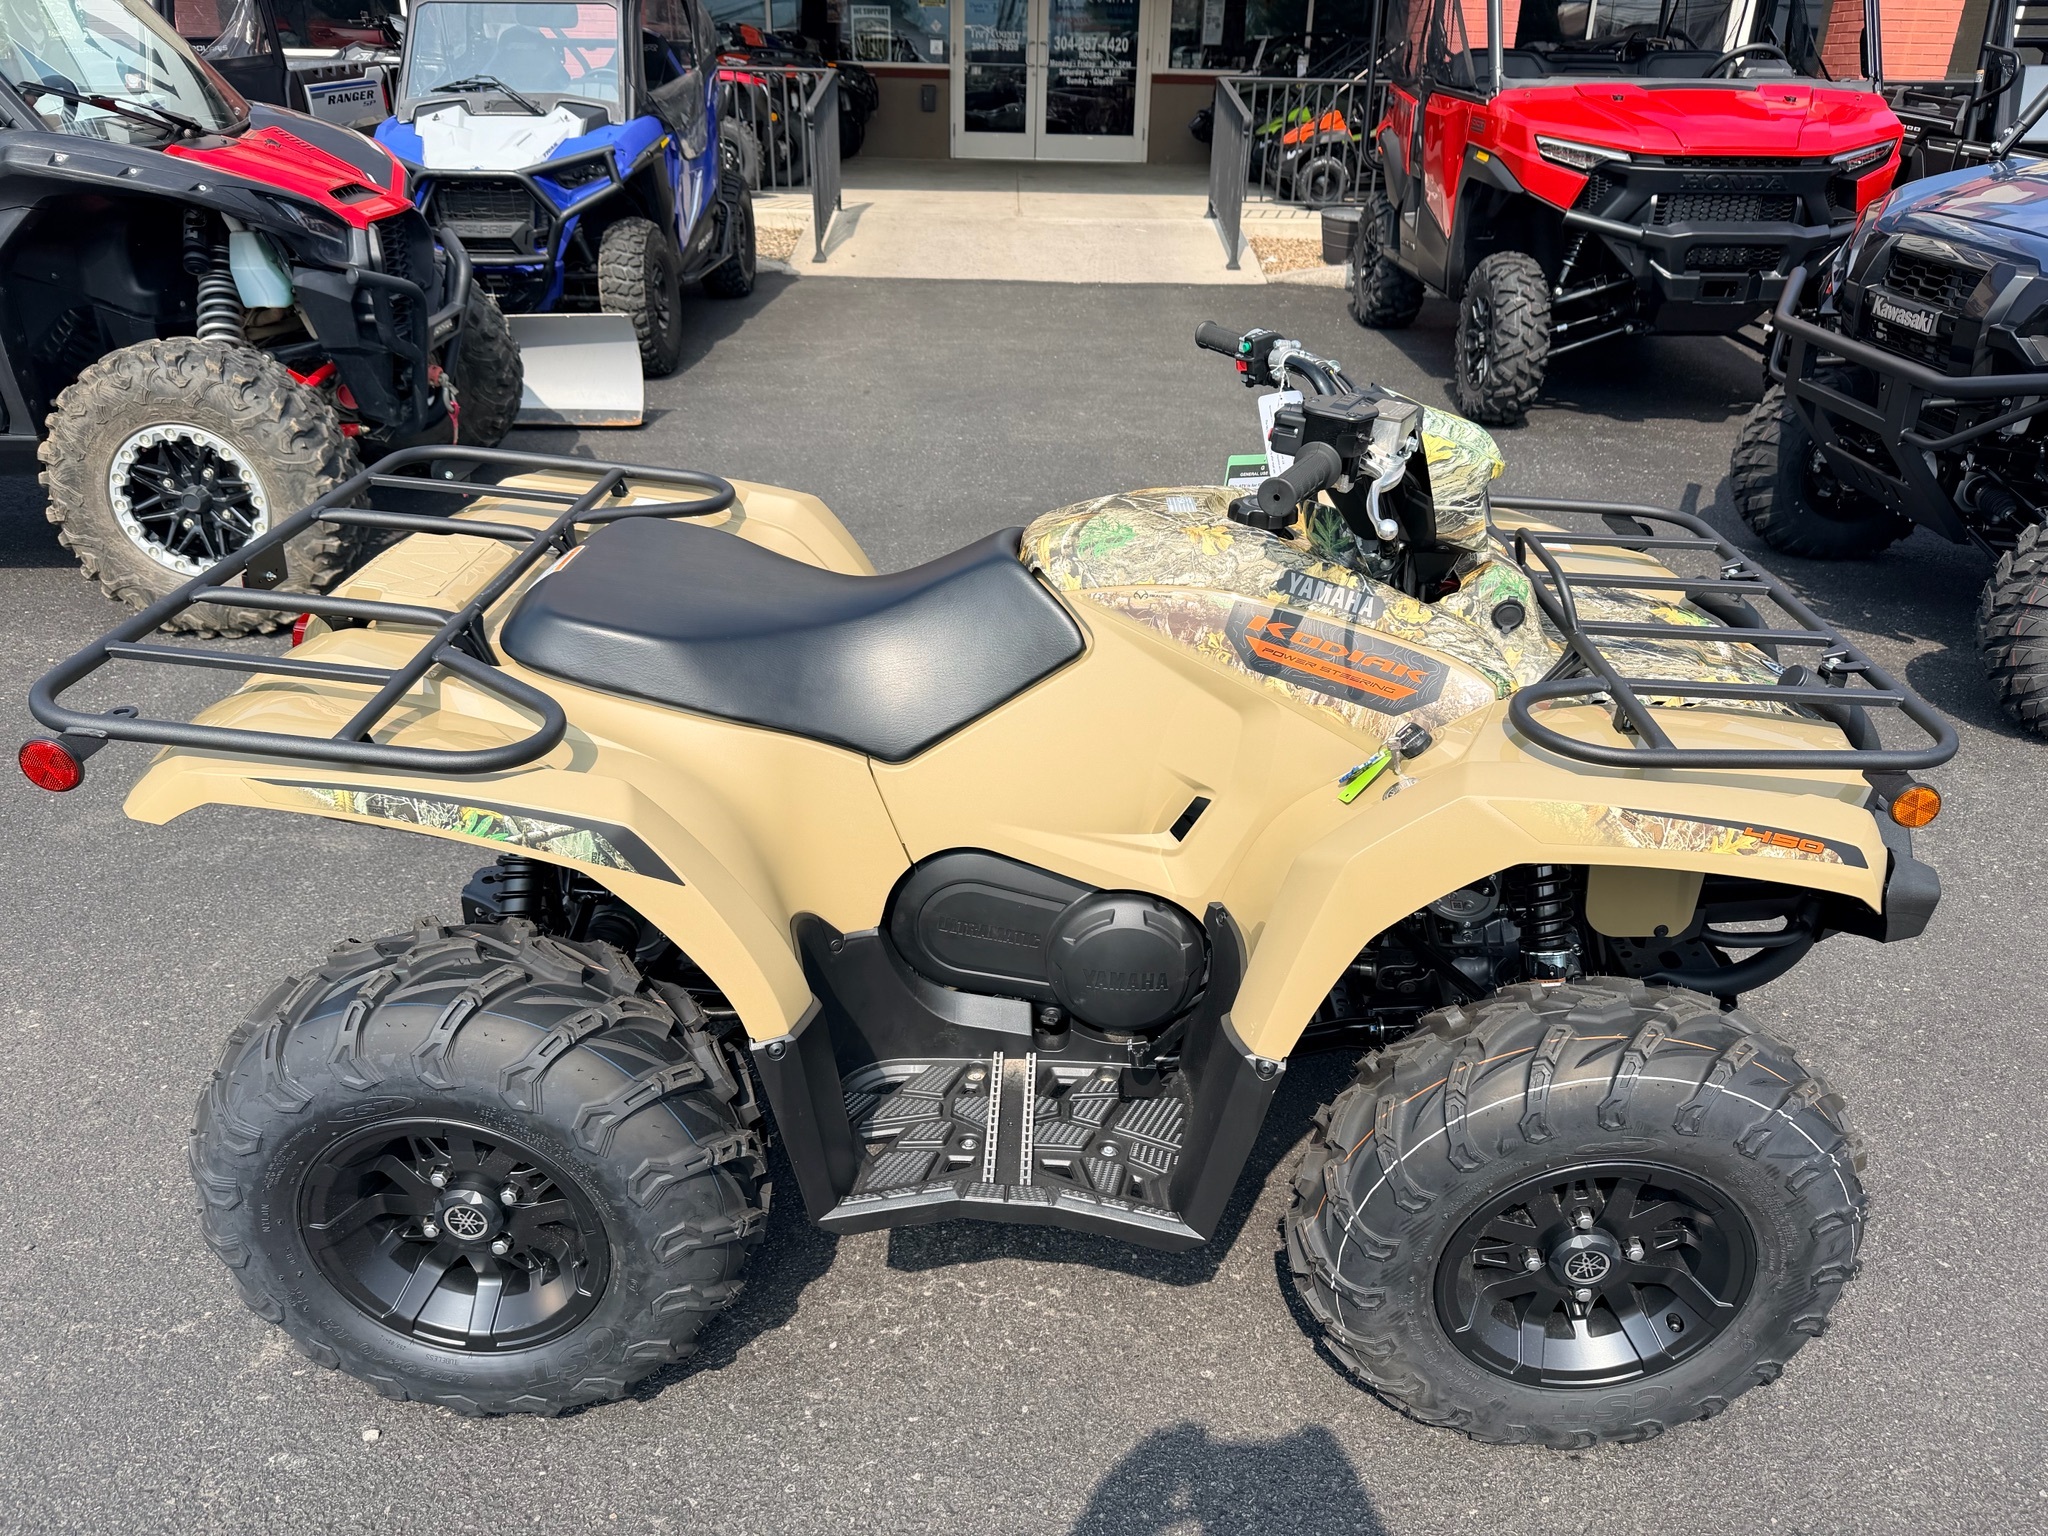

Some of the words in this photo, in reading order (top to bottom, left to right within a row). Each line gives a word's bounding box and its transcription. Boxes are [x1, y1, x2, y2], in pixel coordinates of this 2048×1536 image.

[863, 7, 888, 15] SUPPORT
[1054, 36, 1129, 53] 304-257-4420
[1059, 69, 1086, 77] Saturday
[1077, 60, 1096, 69] Friday
[1066, 77, 1088, 86] Sunday
[327, 90, 374, 106] RANGER
[542, 142, 558, 158] TRAIL
[1680, 173, 1788, 191] HONDA
[455, 224, 513, 235] POLARIS
[1872, 295, 1934, 334] Kawasaki
[1288, 572, 1375, 619] YAMAHA
[1246, 615, 1429, 684] KODIAK
[1262, 646, 1317, 670] POWER
[1320, 665, 1396, 695] STEERING
[1743, 826, 1825, 855] 450
[936, 916, 1040, 950] ULTRAMATIC
[1083, 967, 1169, 993] YAMAHA
[424, 1353, 458, 1366] TUBELESS
[525, 1327, 615, 1390] CST
[1551, 1386, 1672, 1423] CST
